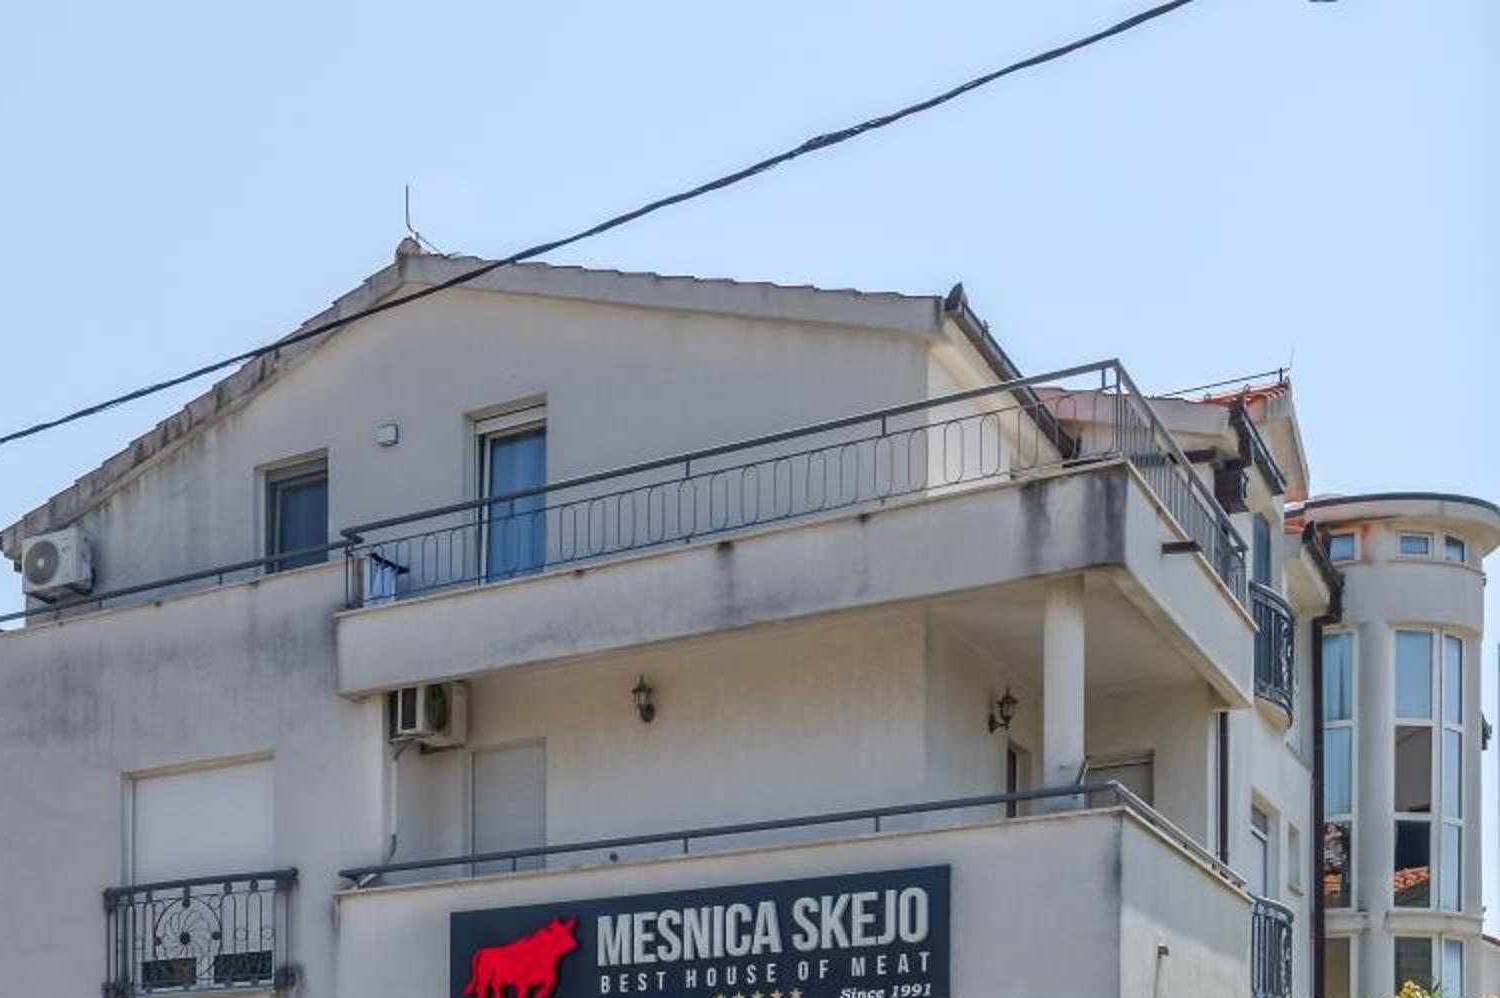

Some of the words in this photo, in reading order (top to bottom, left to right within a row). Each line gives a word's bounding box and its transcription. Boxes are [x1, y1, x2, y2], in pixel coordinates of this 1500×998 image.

[597, 901, 783, 967] MESNICA
[792, 887, 929, 951] SKEJO
[601, 971, 667, 994] BEST
[685, 963, 777, 989] HOUSE
[798, 959, 829, 982] OF
[851, 951, 931, 977] MEAT
[891, 983, 932, 998] 1991
